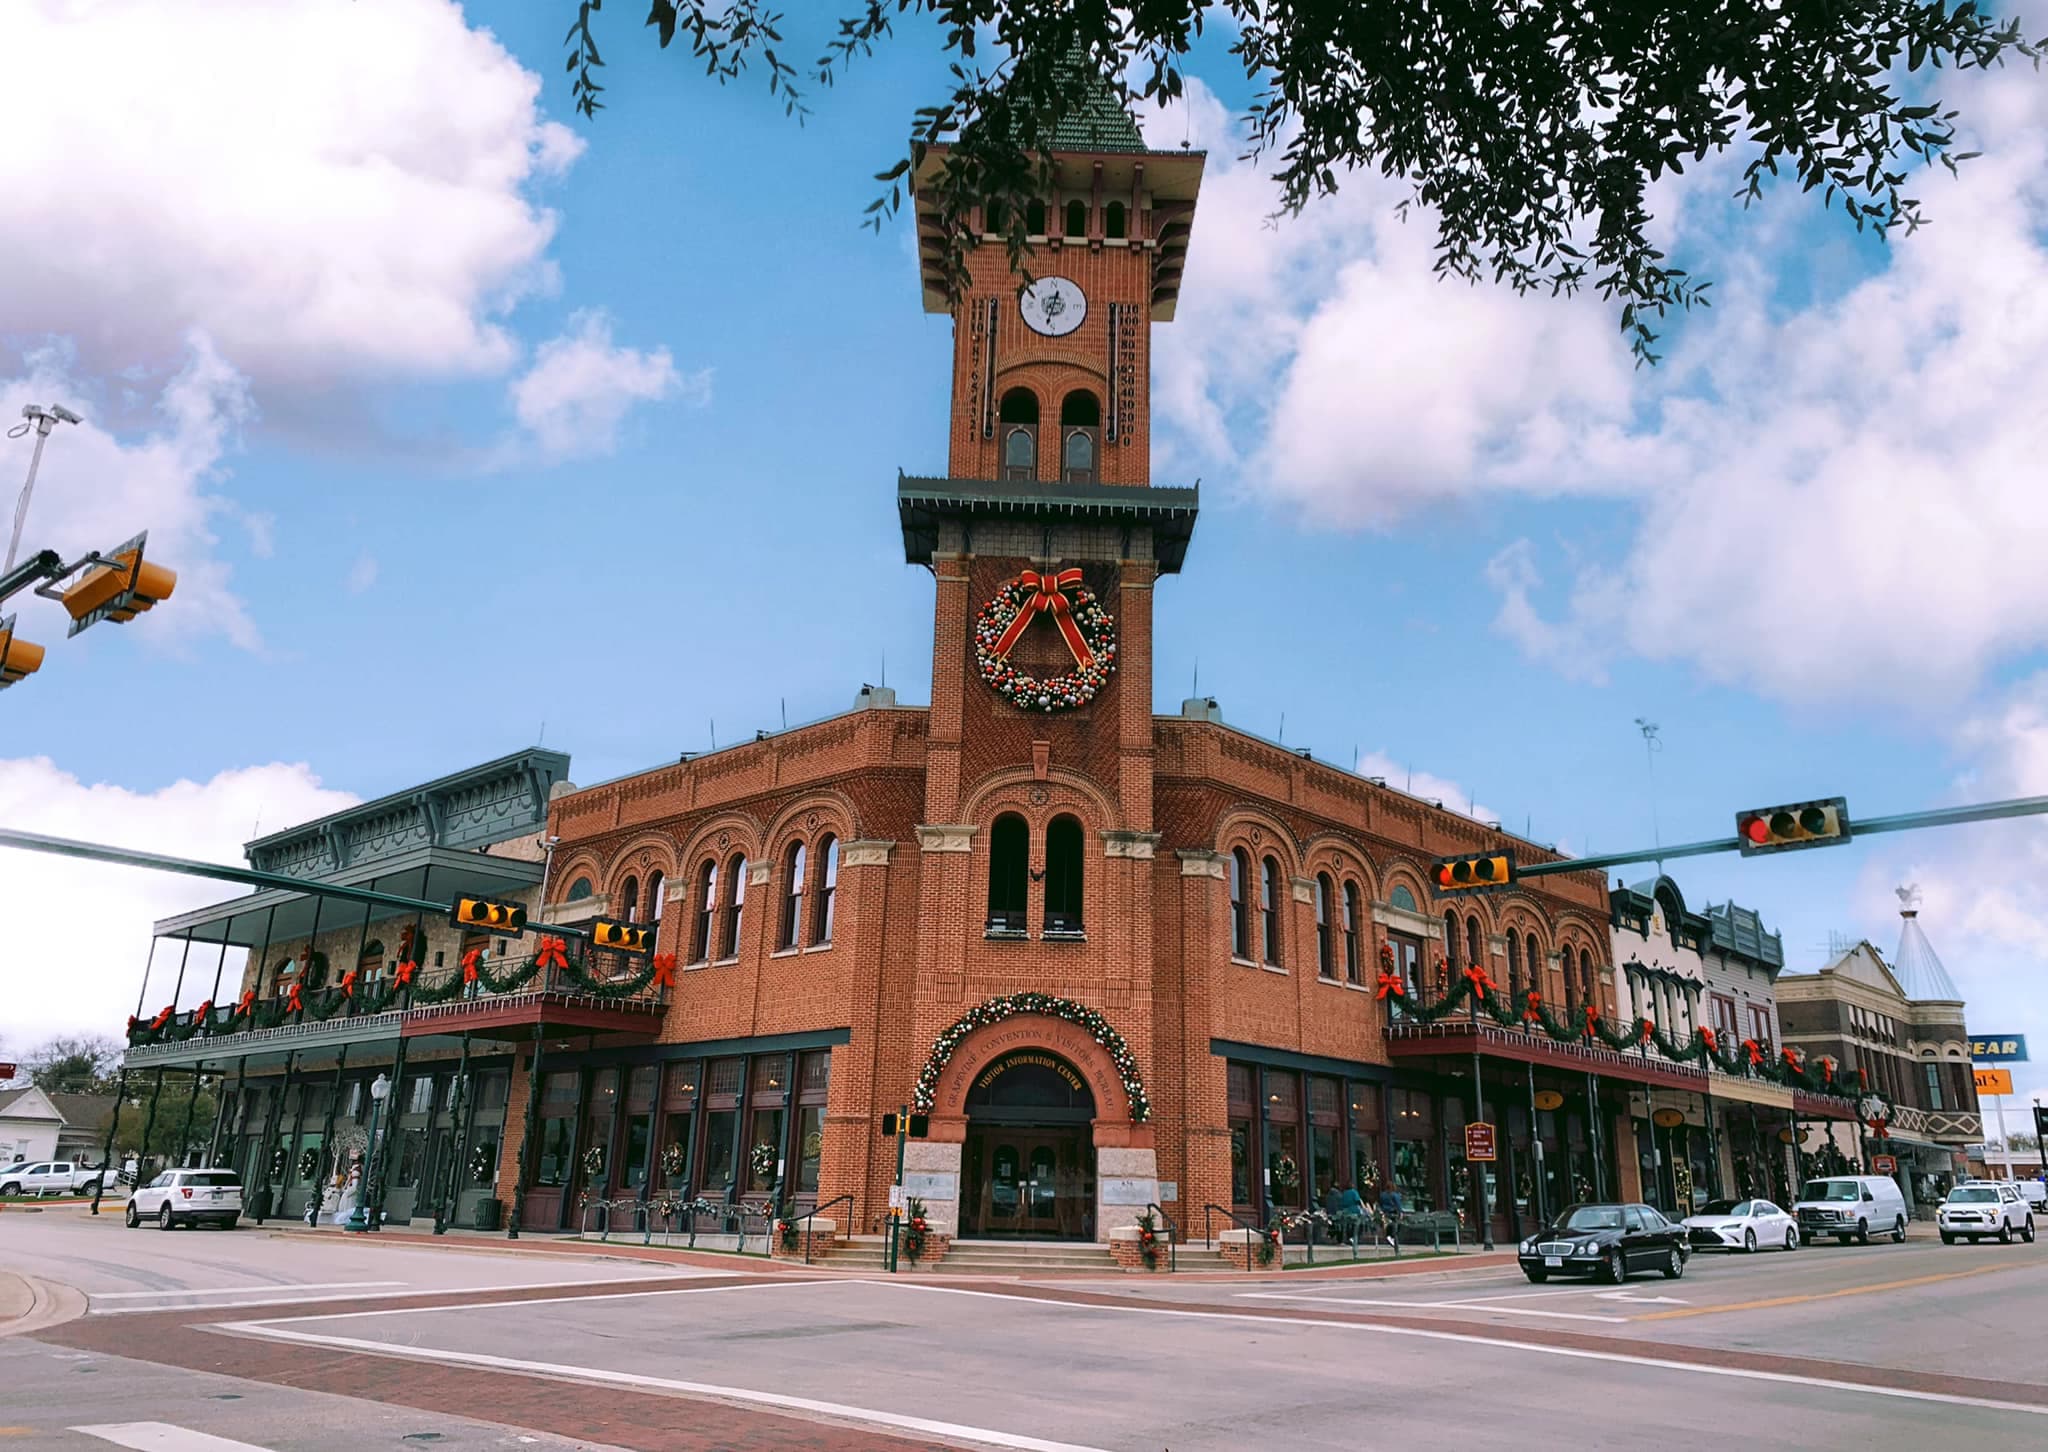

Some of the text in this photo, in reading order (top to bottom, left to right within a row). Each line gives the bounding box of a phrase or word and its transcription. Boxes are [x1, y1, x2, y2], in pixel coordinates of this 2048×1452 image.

[948, 1052, 979, 1108] GRAPEVINE
[980, 1030, 1042, 1056] CONVENTION
[1056, 1034, 1095, 1069] VISITORS
[979, 1055, 1082, 1091] VISITOR INFORMATION CENTER
